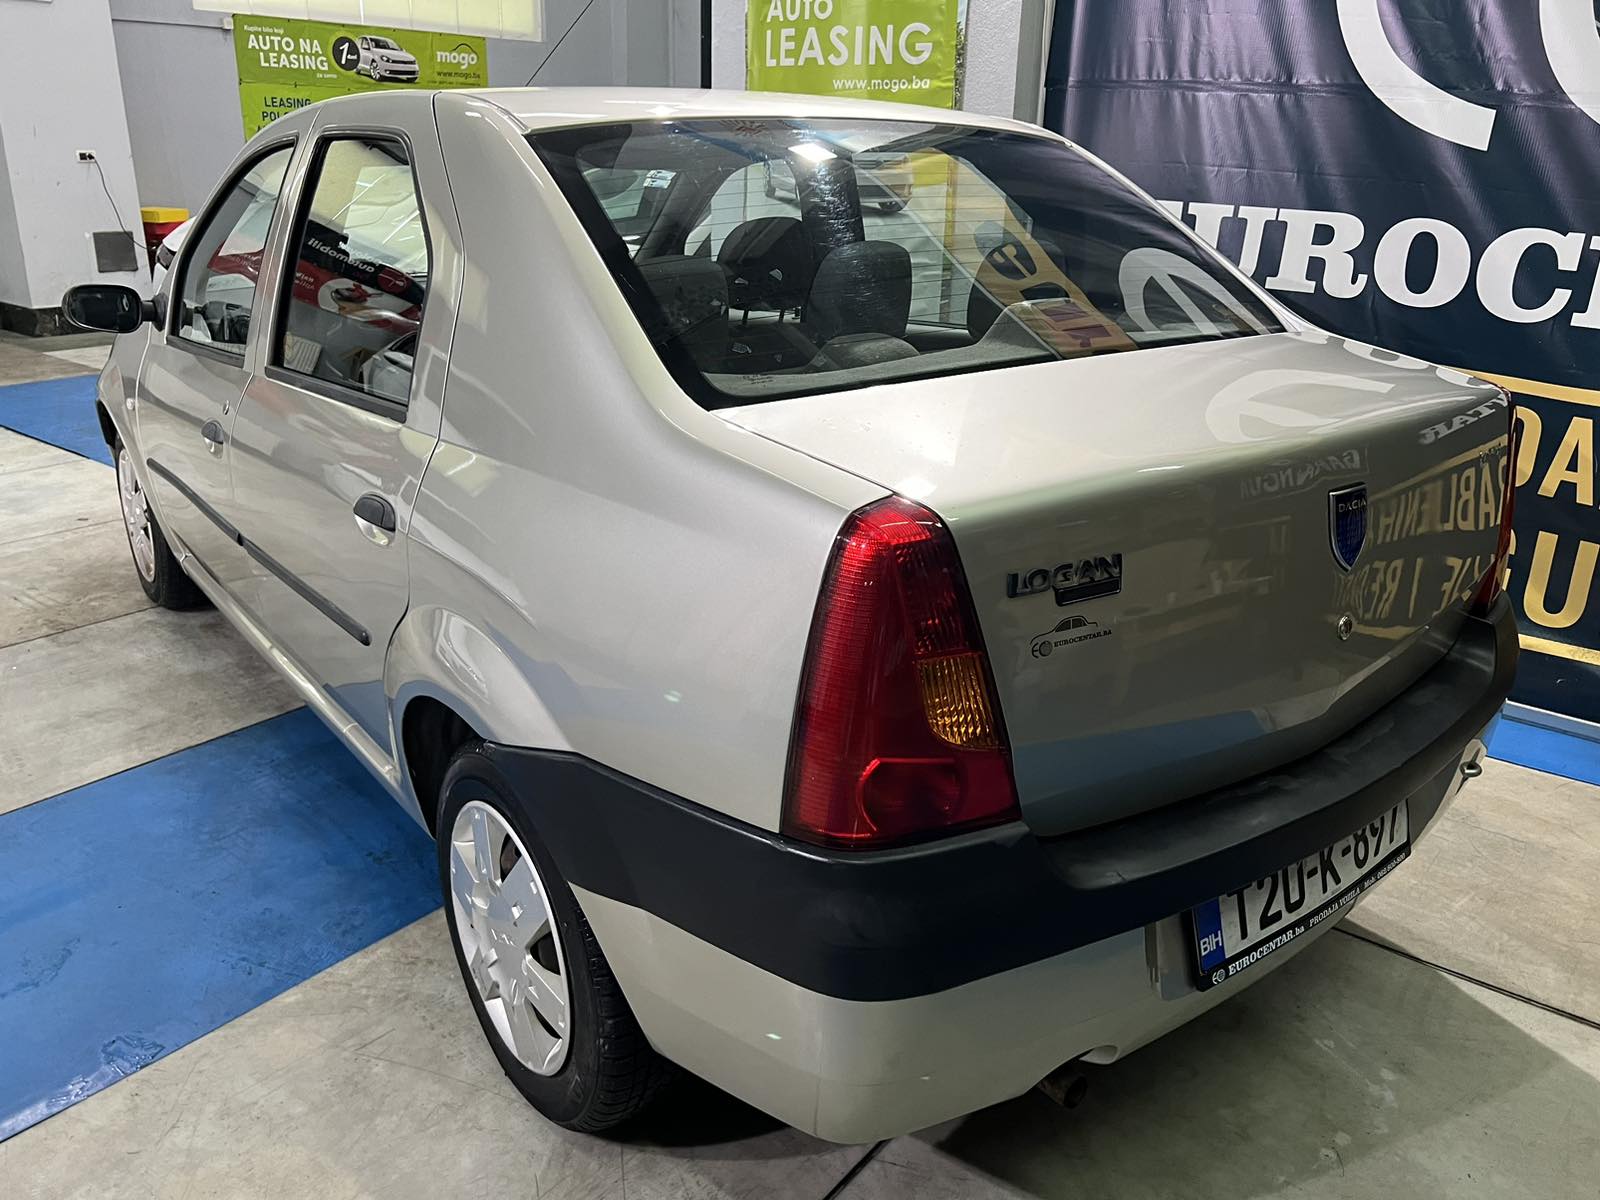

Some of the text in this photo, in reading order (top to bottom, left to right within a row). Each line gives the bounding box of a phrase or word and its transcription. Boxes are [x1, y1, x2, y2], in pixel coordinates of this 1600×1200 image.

[766, 0, 833, 22] AUTO
[248, 34, 323, 54] AUTO NA
[765, 22, 933, 67] LEASING
[259, 52, 329, 71] LEASING
[436, 50, 477, 69] mogo
[832, 75, 930, 93] www.mogo.ba
[263, 96, 312, 108] LEASING
[1338, 496, 1367, 513] DACIA
[1007, 552, 1123, 598] LOGAN
[1054, 629, 1113, 648] EUROCENTAR.BA
[1200, 930, 1223, 957] BIH
[1228, 924, 1306, 976] EUROCENTAR.ba
[1309, 902, 1340, 928] PRODAJA
